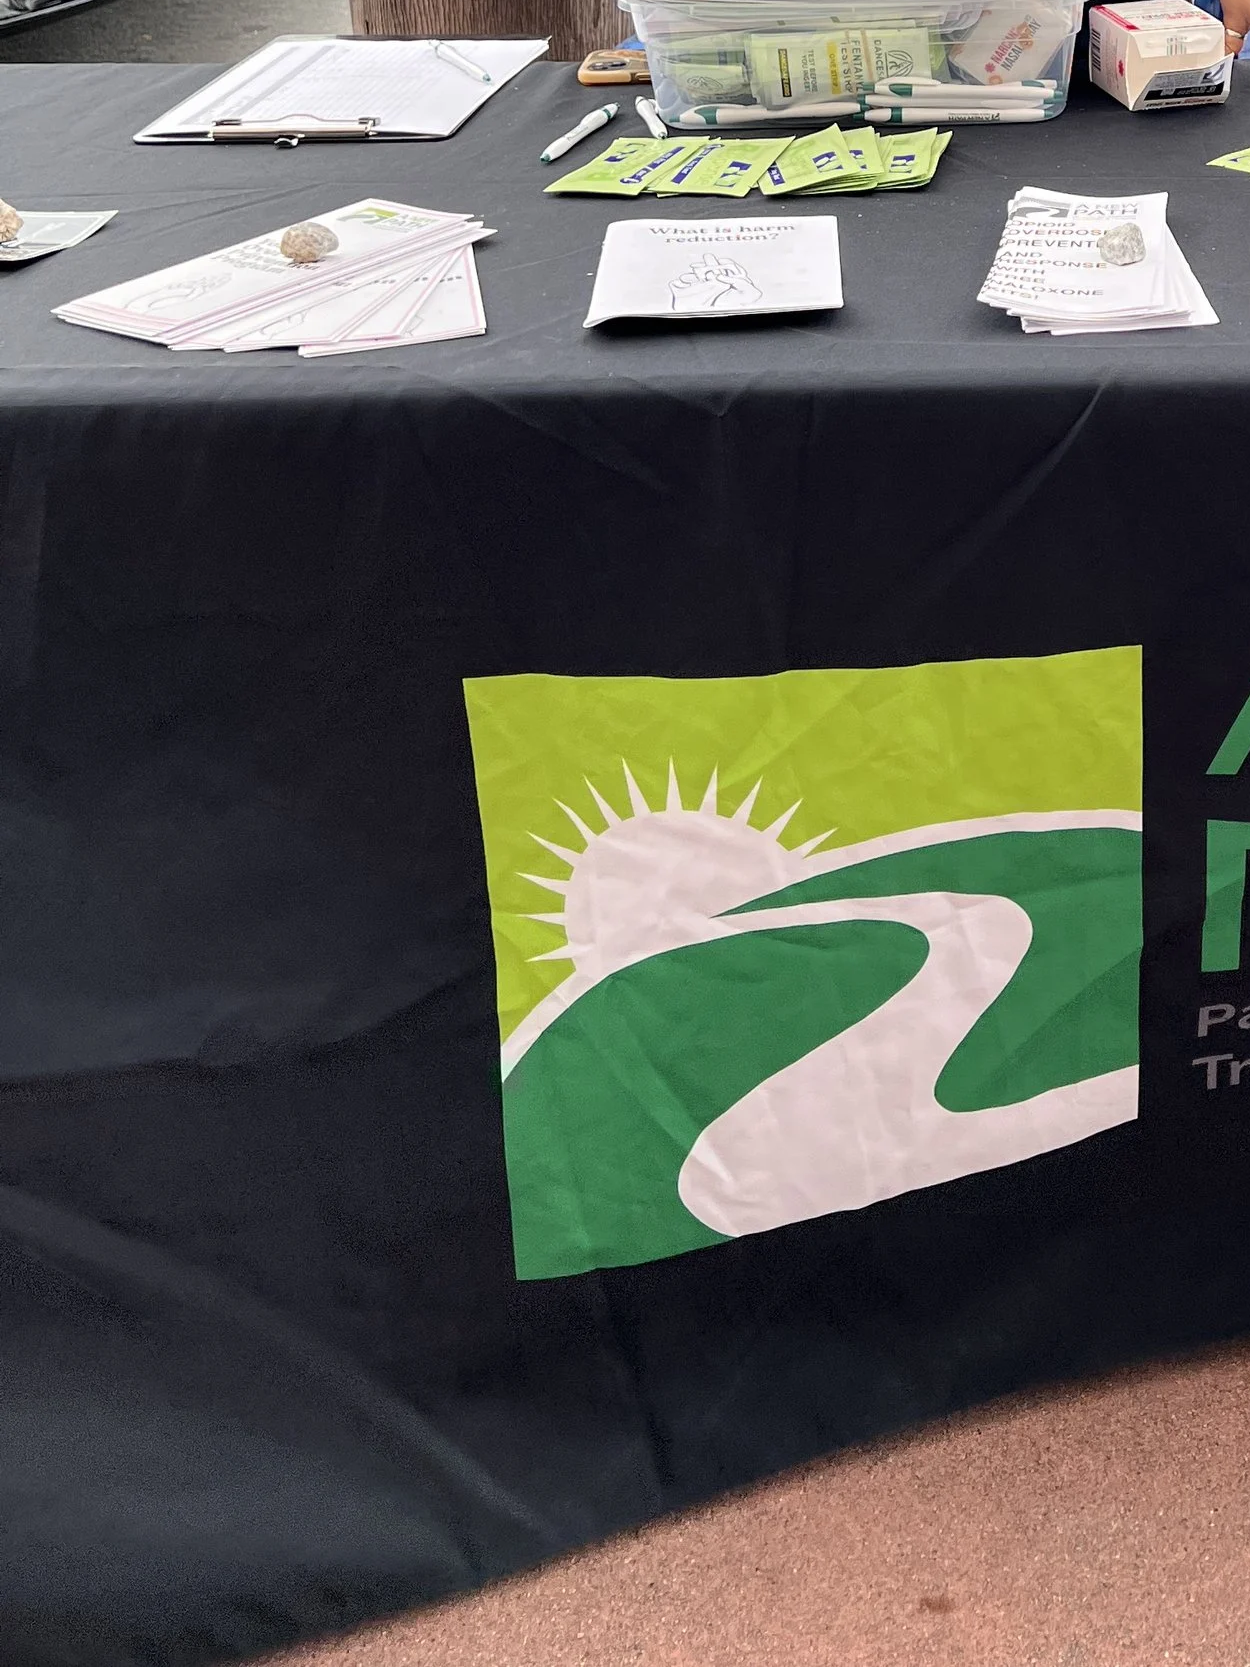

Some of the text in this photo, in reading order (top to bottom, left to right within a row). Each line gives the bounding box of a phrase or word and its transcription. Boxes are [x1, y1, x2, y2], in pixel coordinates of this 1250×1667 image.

[851, 39, 864, 93] FENTANYL
[1073, 208, 1138, 216] PATH
[1010, 220, 1076, 228] OPIOID
[649, 227, 708, 235] What
[739, 224, 795, 233] harm
[665, 232, 779, 244] reduction?
[1004, 238, 1101, 248] PREVENTI
[1001, 250, 1043, 258] AND
[999, 257, 1108, 269] RESPONSE
[996, 265, 1045, 275] WITH
[990, 279, 1105, 296] NALOXONE
